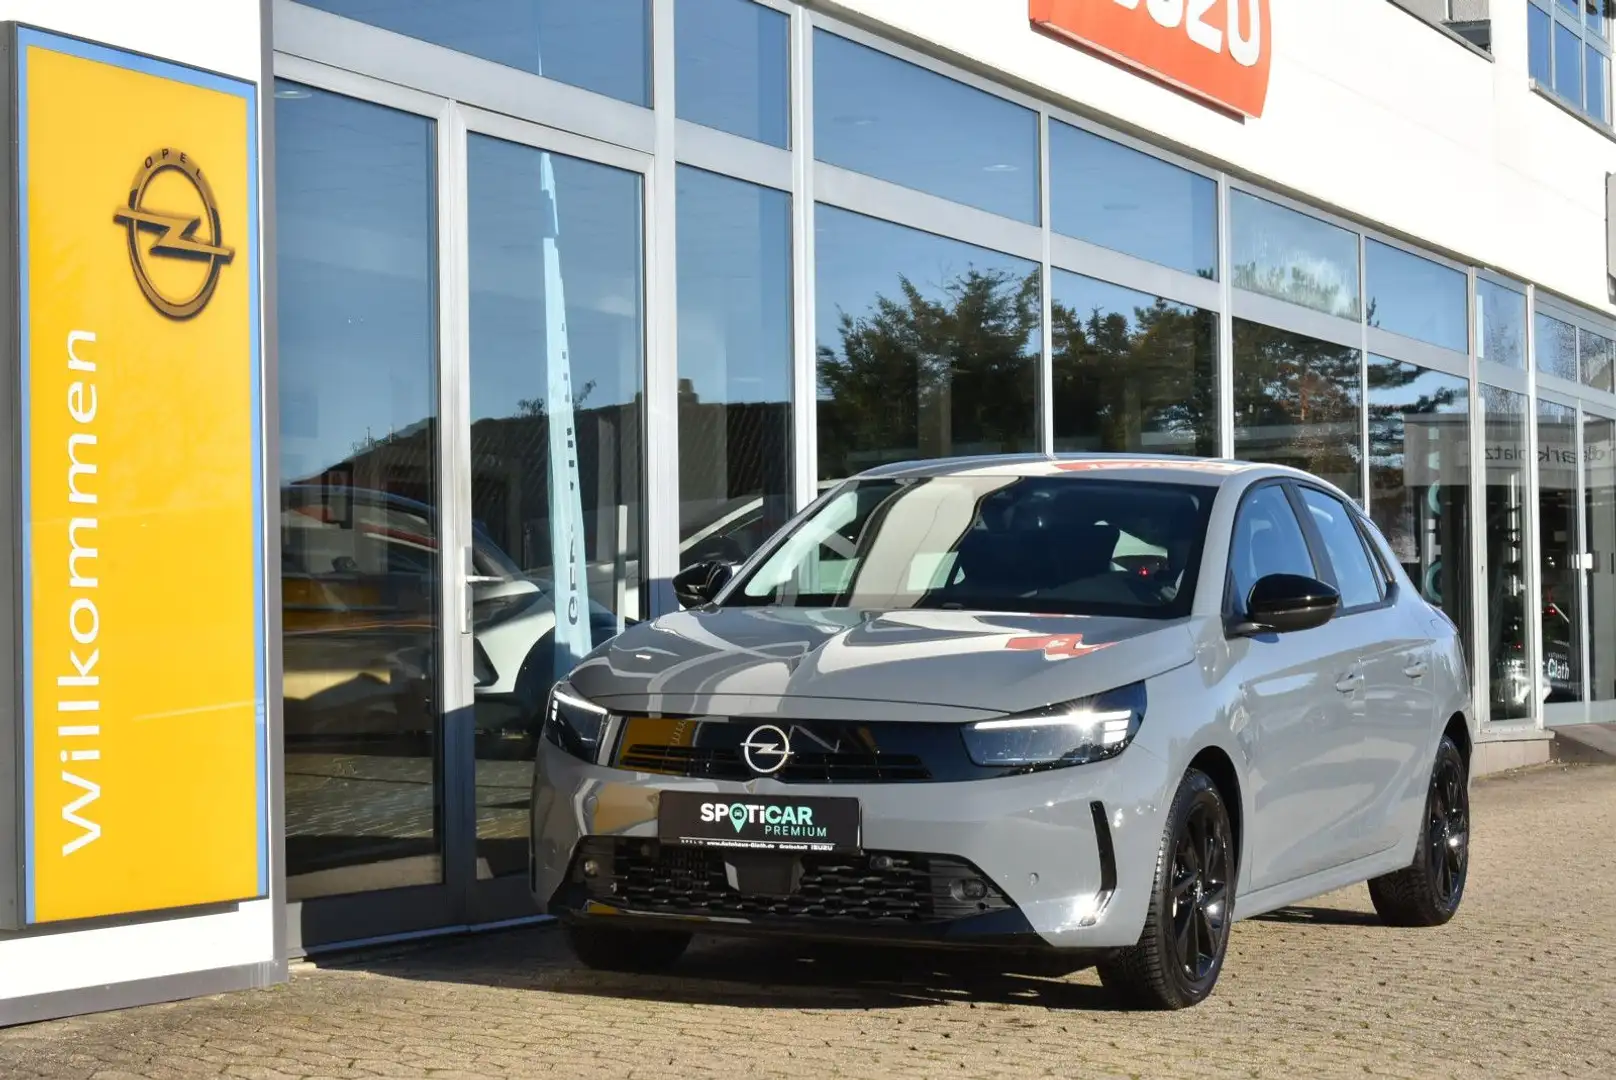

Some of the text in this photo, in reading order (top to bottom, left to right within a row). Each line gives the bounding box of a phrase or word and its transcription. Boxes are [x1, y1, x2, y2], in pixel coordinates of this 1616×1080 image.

[144, 148, 202, 181] OPEL
[57, 330, 101, 858] Willkommen
[764, 825, 827, 837] PREMIUM
